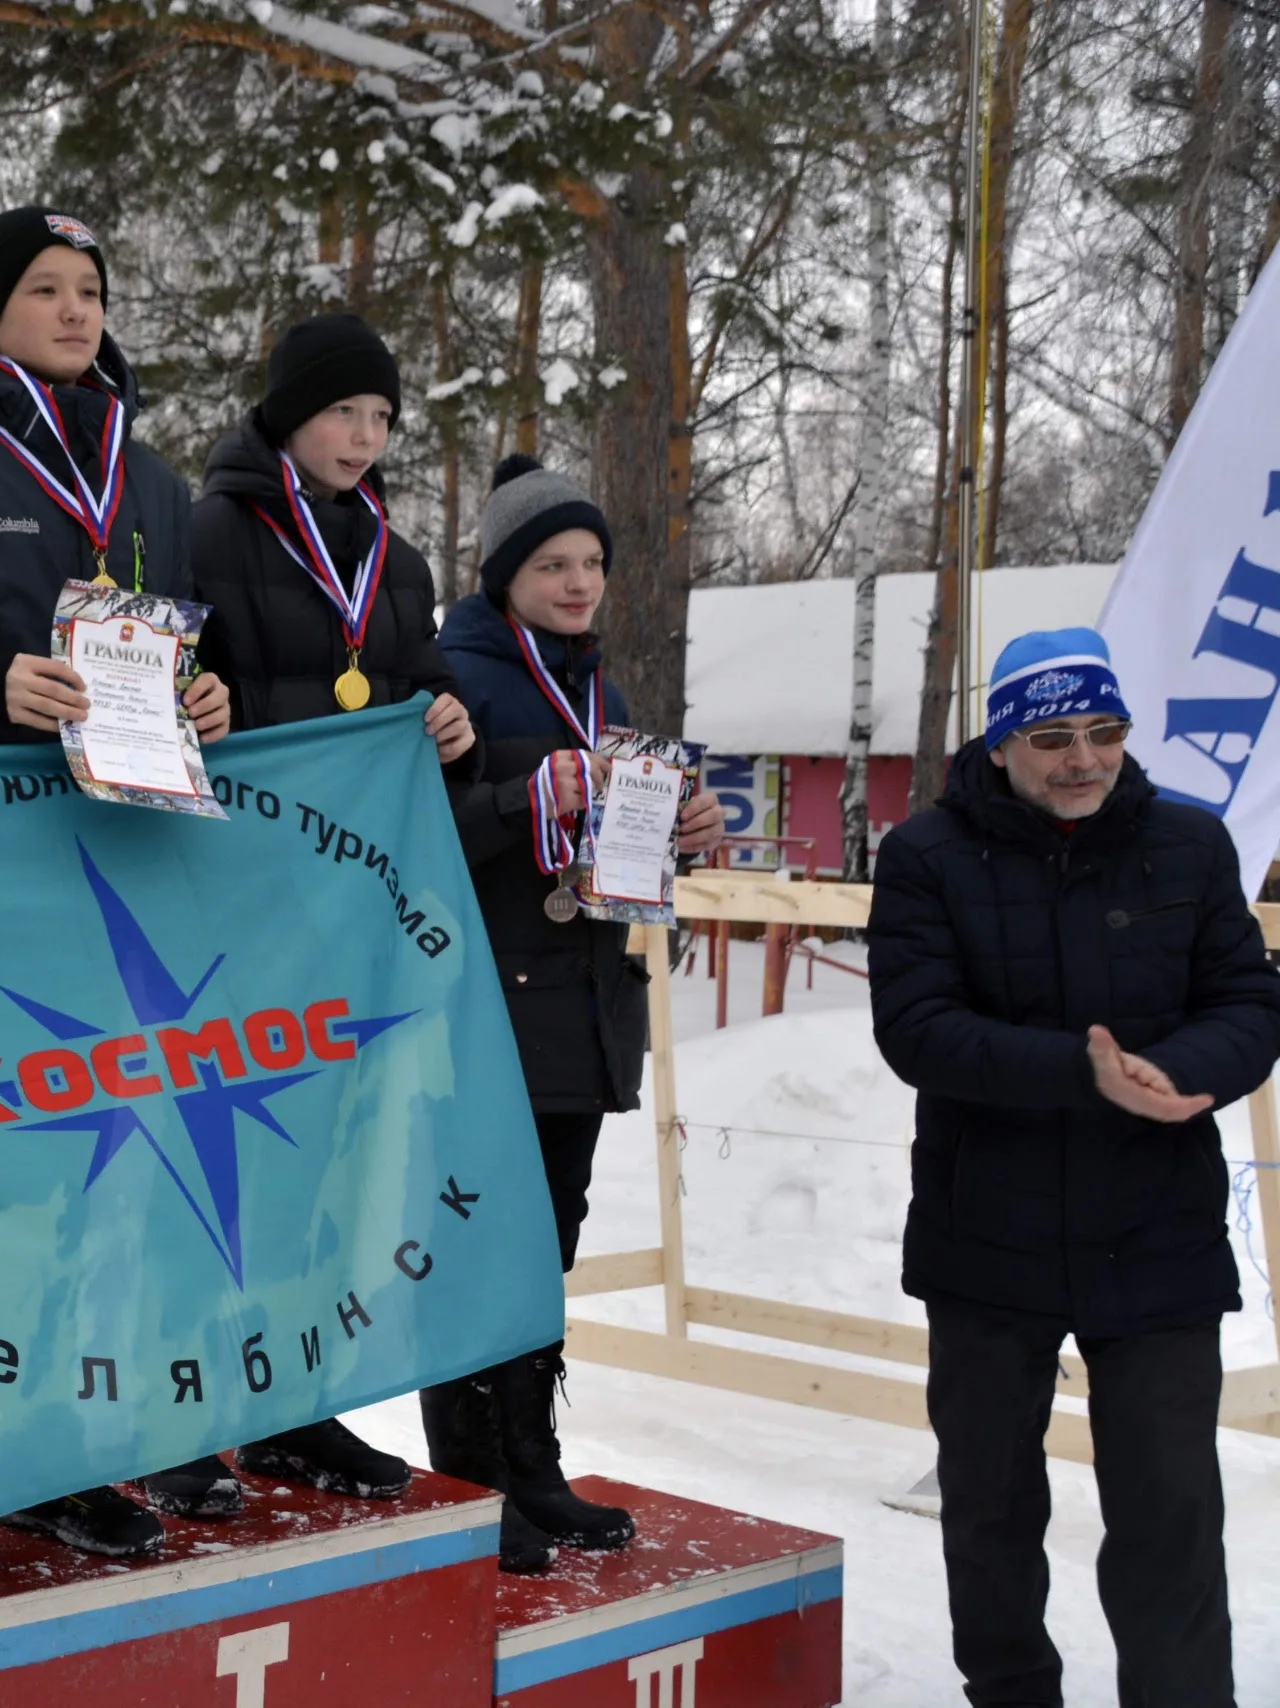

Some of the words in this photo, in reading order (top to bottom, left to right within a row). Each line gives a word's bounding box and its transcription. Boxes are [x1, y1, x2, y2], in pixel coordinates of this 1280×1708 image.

[83, 638, 163, 667] ГРАМОТА
[1022, 699, 1091, 723] 2014
[618, 774, 672, 795] ГРАМОТА
[296, 802, 451, 958] туризма
[628, 1636, 705, 1708] III
